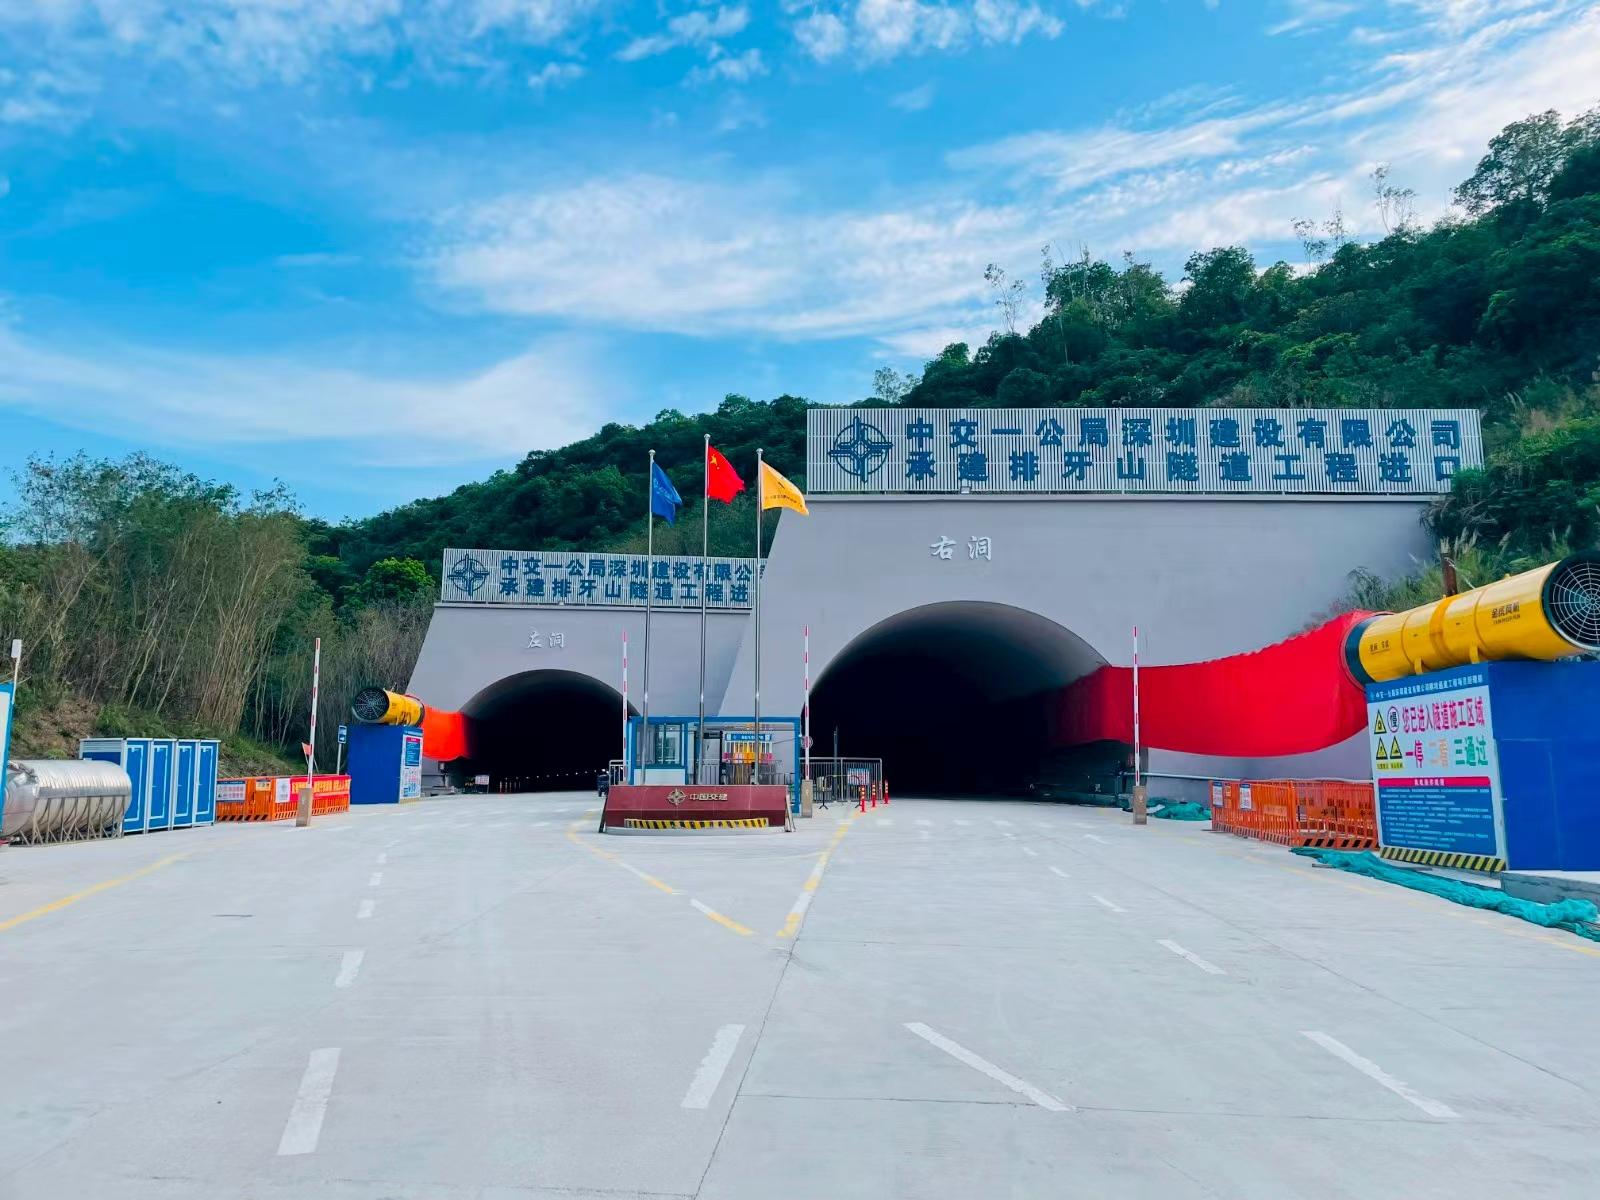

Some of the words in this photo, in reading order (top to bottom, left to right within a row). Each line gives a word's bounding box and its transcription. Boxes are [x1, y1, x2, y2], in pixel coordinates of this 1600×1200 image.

[906, 417, 1460, 449] 中交一公局深圳建设有限公司
[905, 451, 1461, 482] 承建排牙山隧道工程进口
[929, 535, 992, 561] 右洞
[501, 556, 765, 581] 中交一公局深圳建设有限公
[500, 577, 748, 602] 承建排牙山隧道工程进
[527, 631, 564, 648] 左洞
[1402, 696, 1485, 733] 您已进入隧道施工区域
